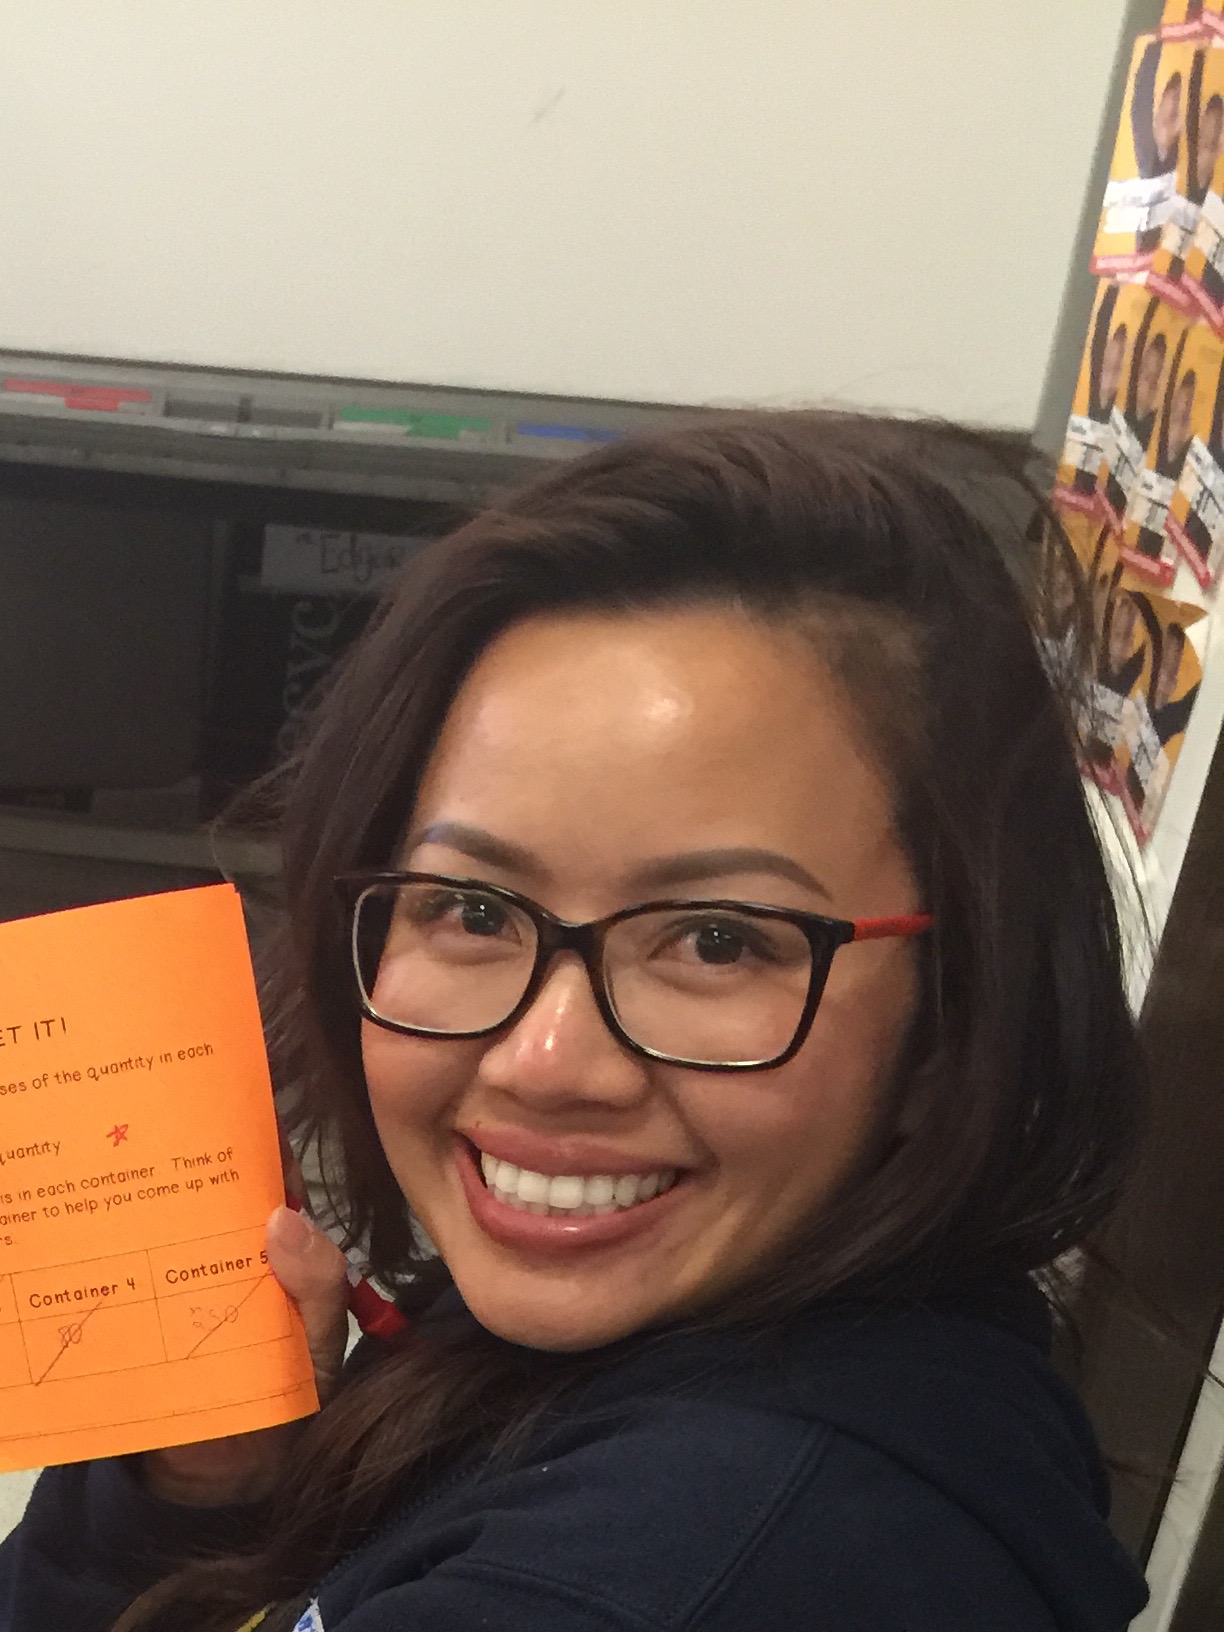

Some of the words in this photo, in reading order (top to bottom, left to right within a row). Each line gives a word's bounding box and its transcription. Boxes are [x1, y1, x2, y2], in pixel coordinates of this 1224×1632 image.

[32, 1073, 48, 1089] of
[54, 1070, 81, 1084] the
[87, 1056, 153, 1081] quantity
[159, 1053, 172, 1063] in
[177, 1043, 213, 1060] each
[0, 1194, 12, 1203] is
[18, 1190, 31, 1200] in
[37, 1180, 76, 1198] each
[81, 1167, 154, 1189] container
[171, 1152, 212, 1170] Think
[217, 1147, 233, 1162] of
[42, 1206, 60, 1218] to
[65, 1198, 98, 1214] help
[104, 1193, 132, 1211] you
[137, 1184, 179, 1200] come
[186, 1179, 203, 1192] up
[209, 1169, 239, 1185] with
[165, 1256, 253, 1284] Container
[259, 1249, 269, 1265] 5
[28, 1284, 119, 1308] Container
[125, 1277, 136, 1291] 4
